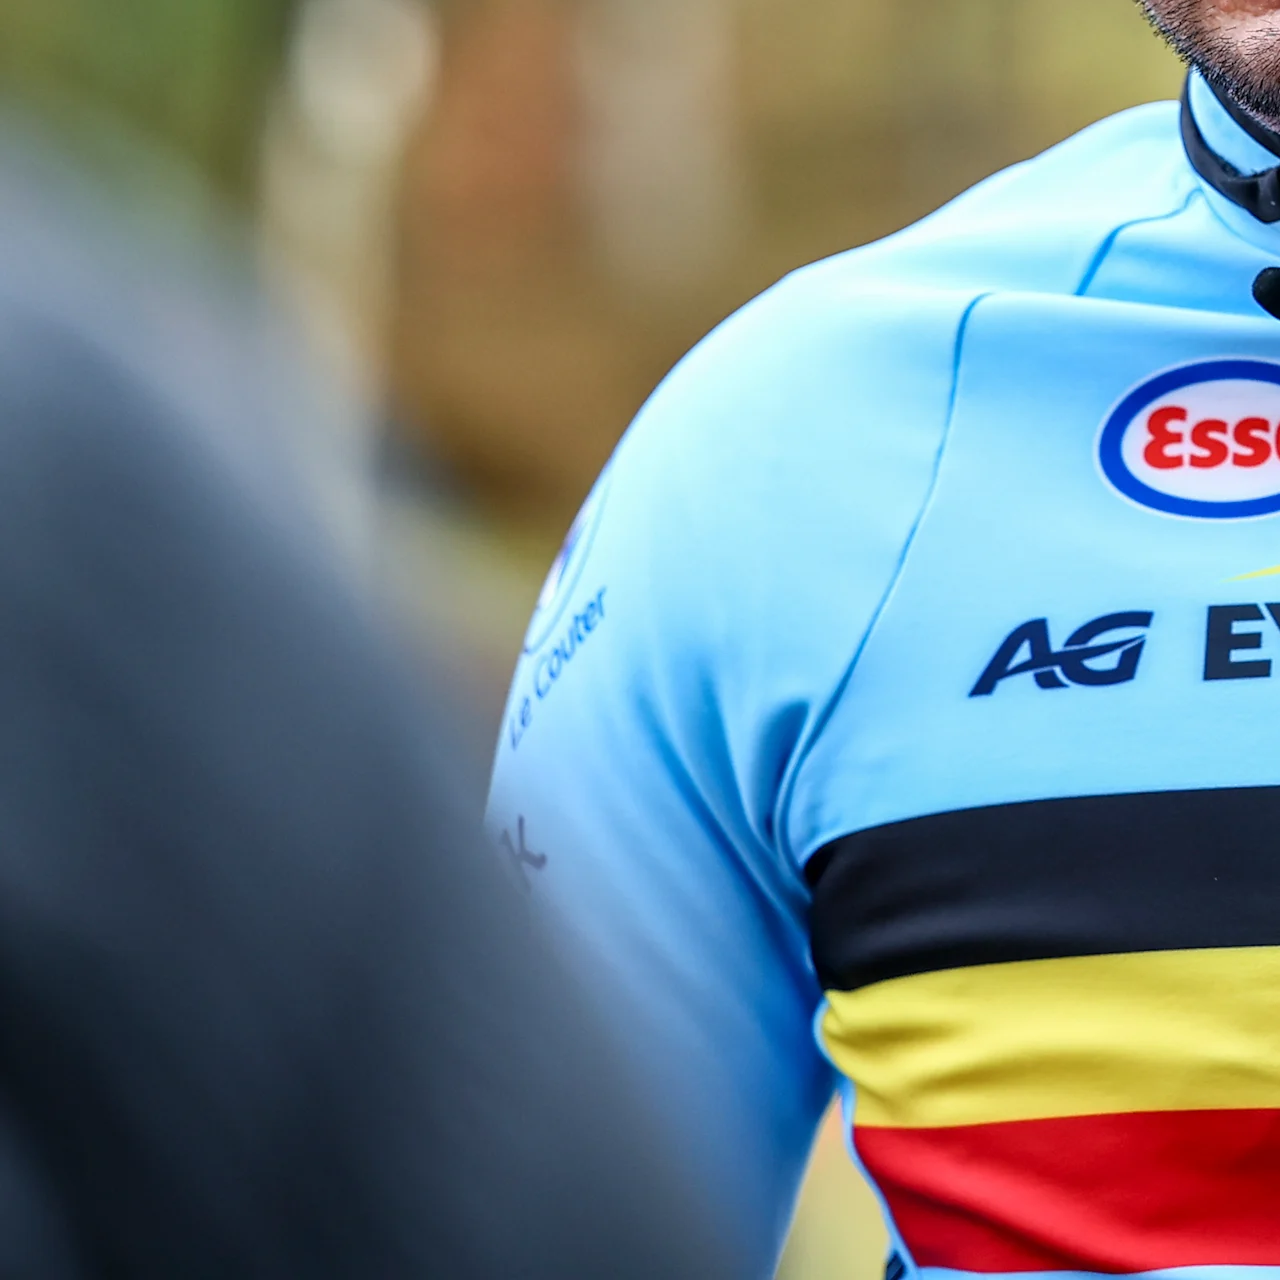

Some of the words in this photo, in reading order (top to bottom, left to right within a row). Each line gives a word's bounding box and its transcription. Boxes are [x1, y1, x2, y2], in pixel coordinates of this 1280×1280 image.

[509, 696, 532, 752] Le
[534, 585, 607, 700] Couter
[967, 610, 1155, 699] AG
